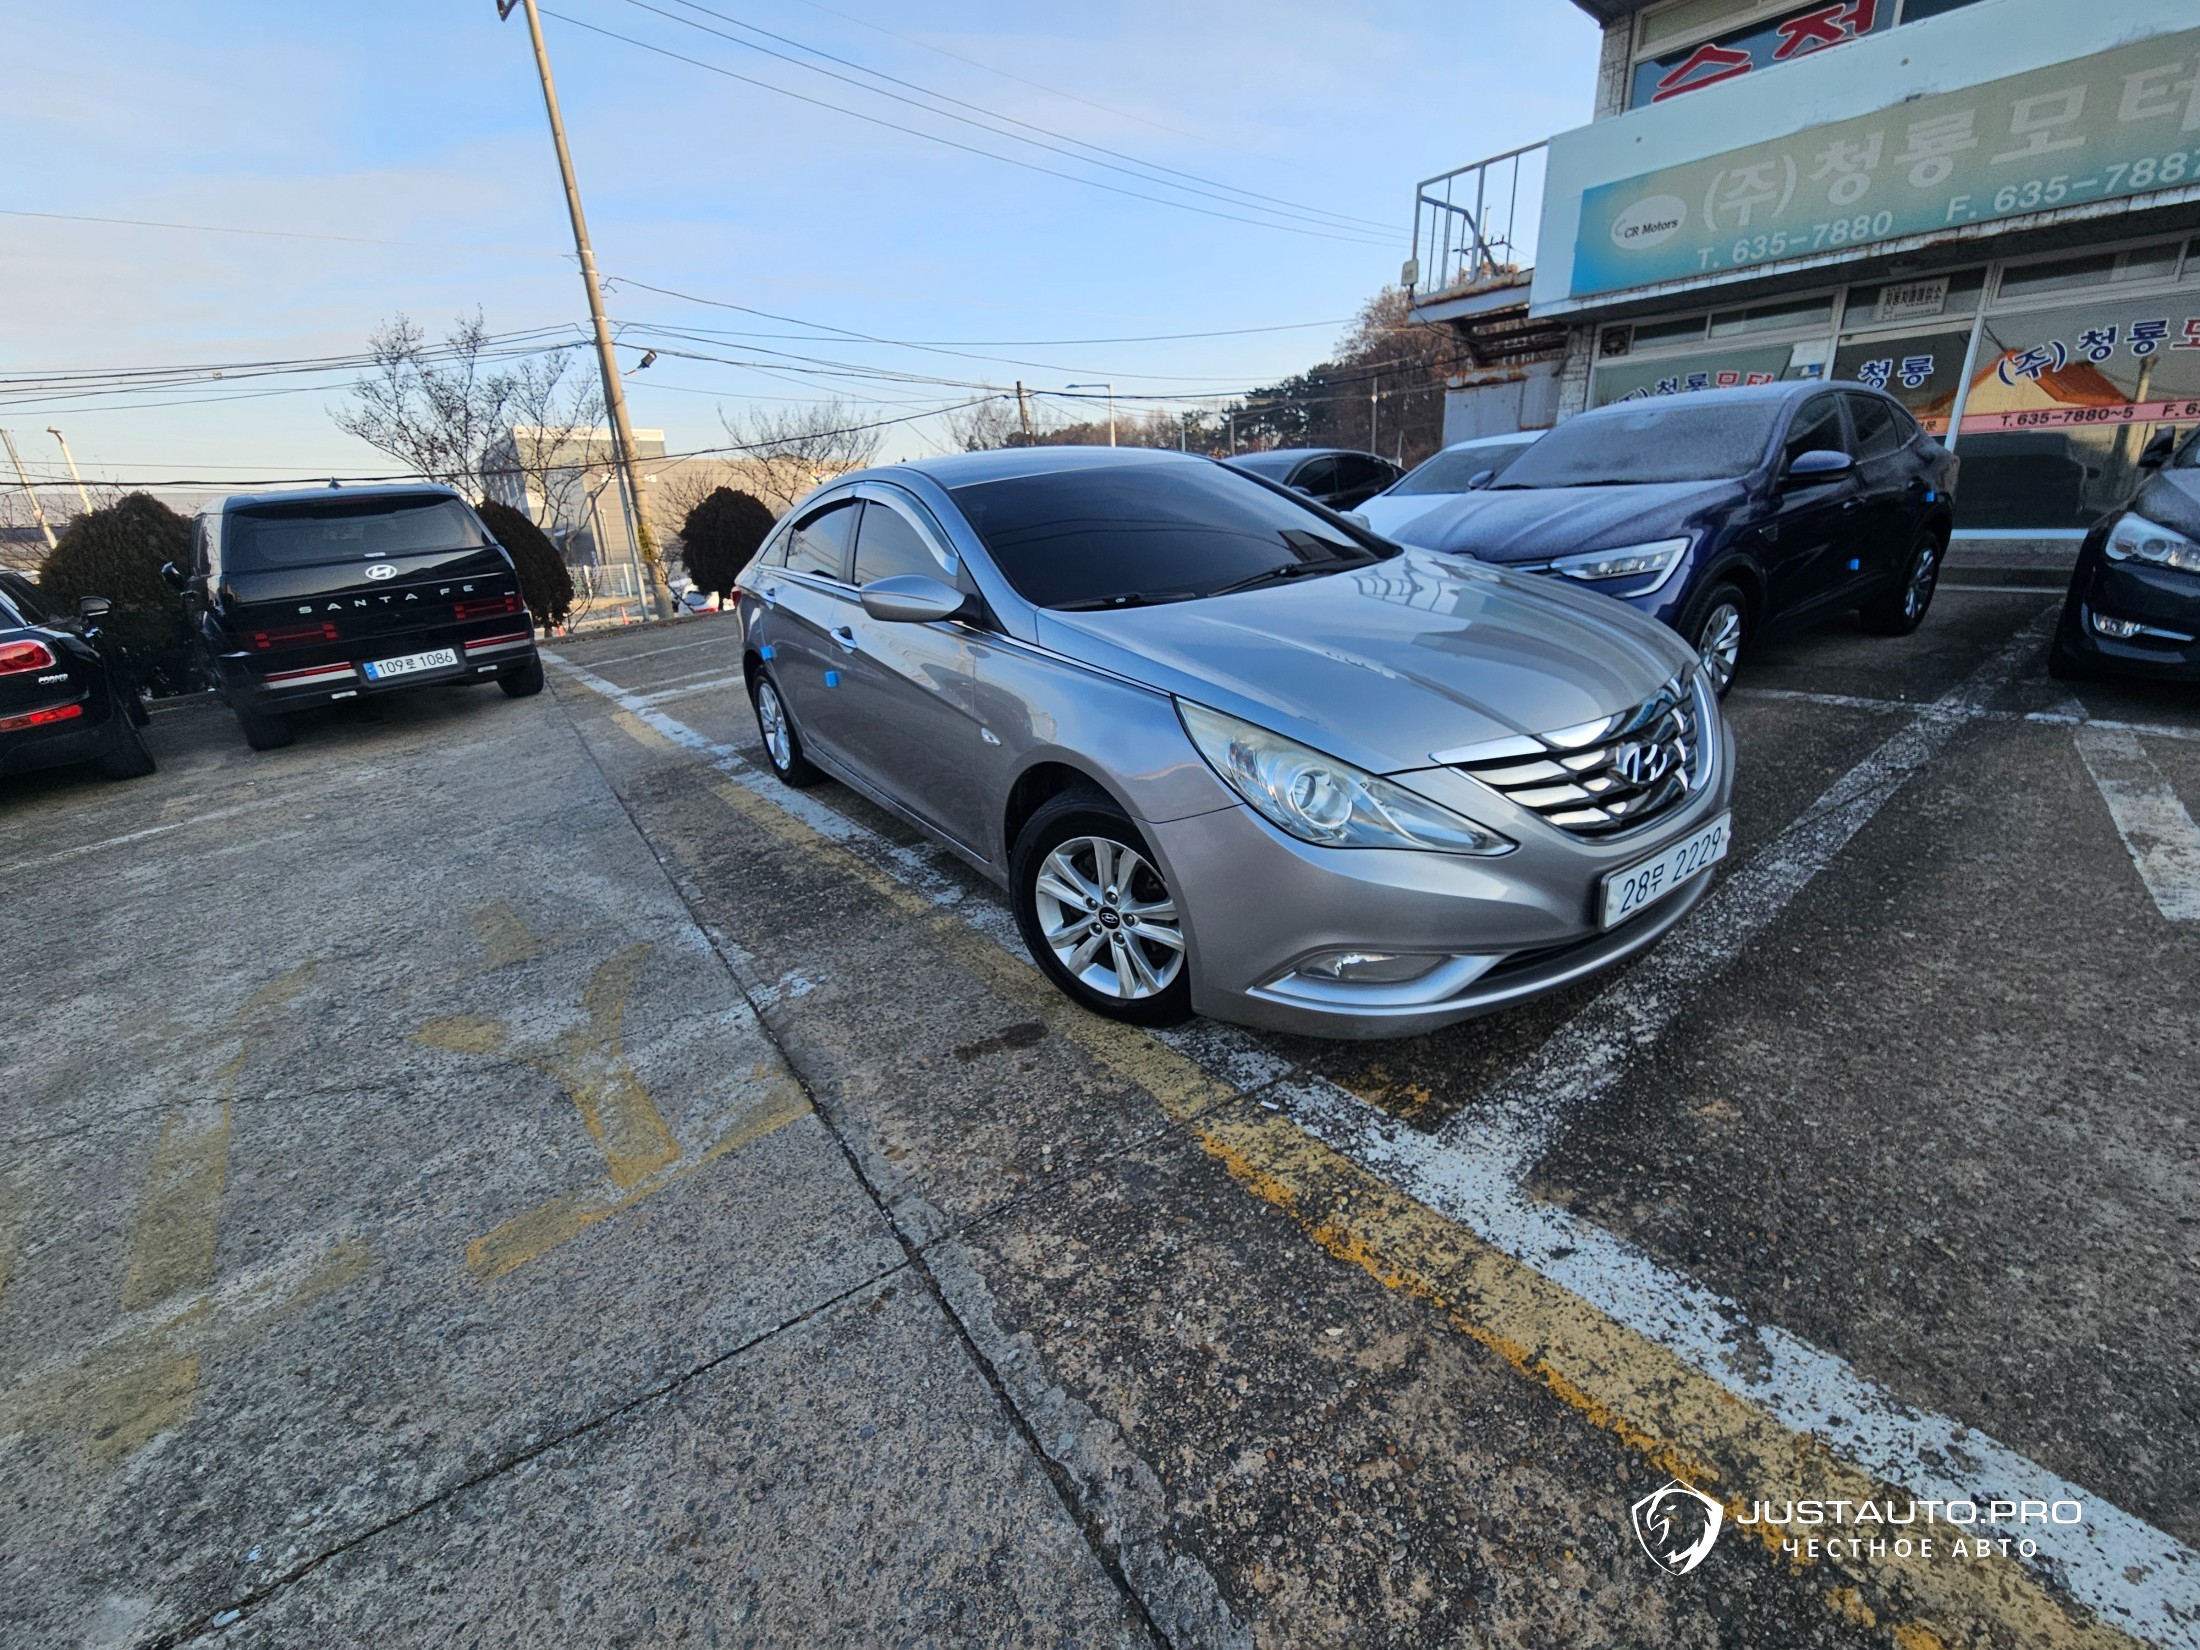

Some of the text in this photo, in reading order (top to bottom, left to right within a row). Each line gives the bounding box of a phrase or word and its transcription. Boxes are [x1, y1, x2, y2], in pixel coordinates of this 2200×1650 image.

[1624, 218, 1678, 239] CR Motors
[1732, 210, 1894, 265] 635-7880
[1858, 355, 1934, 389] 청룡
[299, 584, 474, 614] SANTA FE
[378, 651, 453, 675] 109로 1086
[1620, 826, 1722, 914] 28무 2229
